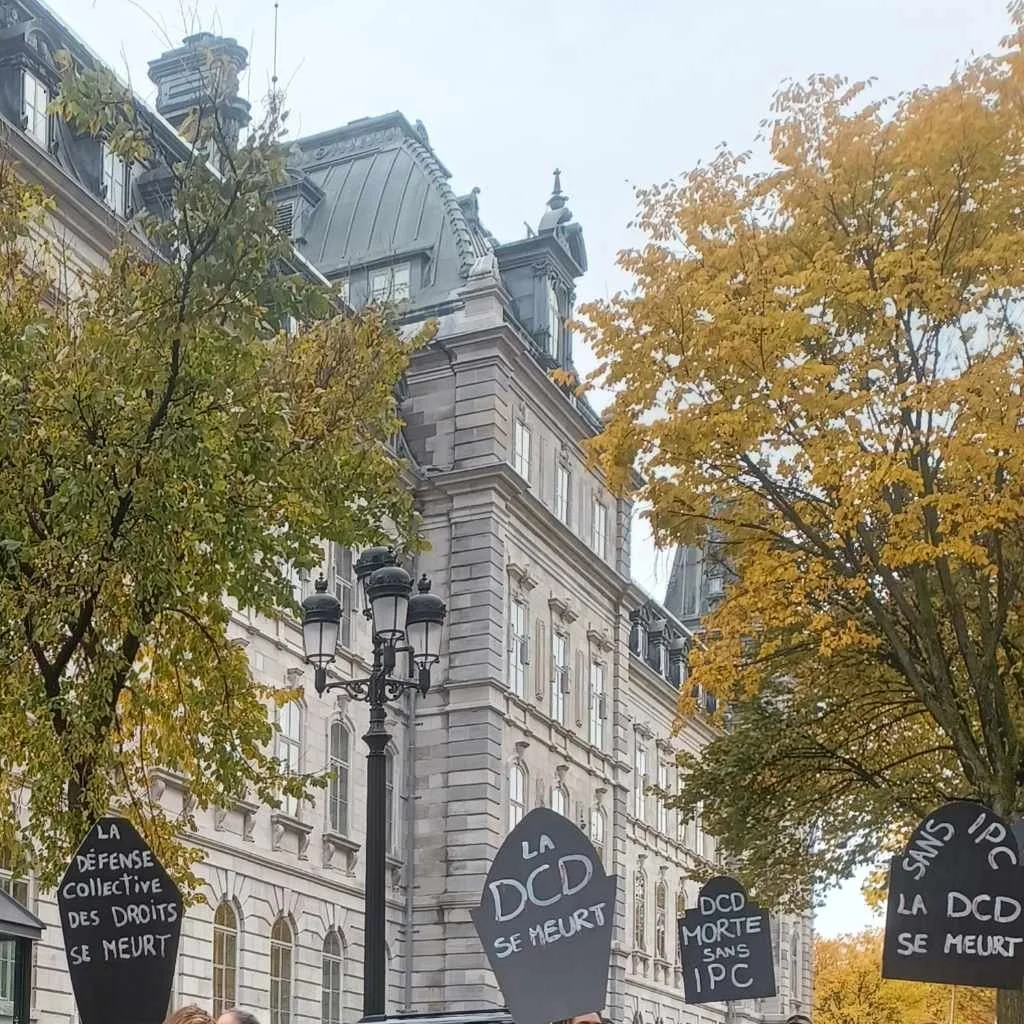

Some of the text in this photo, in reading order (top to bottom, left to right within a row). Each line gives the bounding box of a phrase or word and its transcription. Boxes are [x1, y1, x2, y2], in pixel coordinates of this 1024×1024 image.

[97, 824, 120, 839] LA
[76, 849, 155, 872] DÉFENSE
[521, 834, 555, 860] LA
[902, 812, 1017, 881] SANS IPC
[489, 854, 593, 922] DCD
[700, 892, 745, 915] DCD
[897, 891, 1022, 923] LA DCD
[68, 910, 100, 928] DES
[494, 902, 607, 958] SE MEURT
[682, 916, 762, 946] MORTE
[70, 934, 172, 965] SE MEURT
[702, 944, 750, 962] SANS
[897, 932, 1023, 958] SE MEURT
[695, 963, 753, 993] IPC
